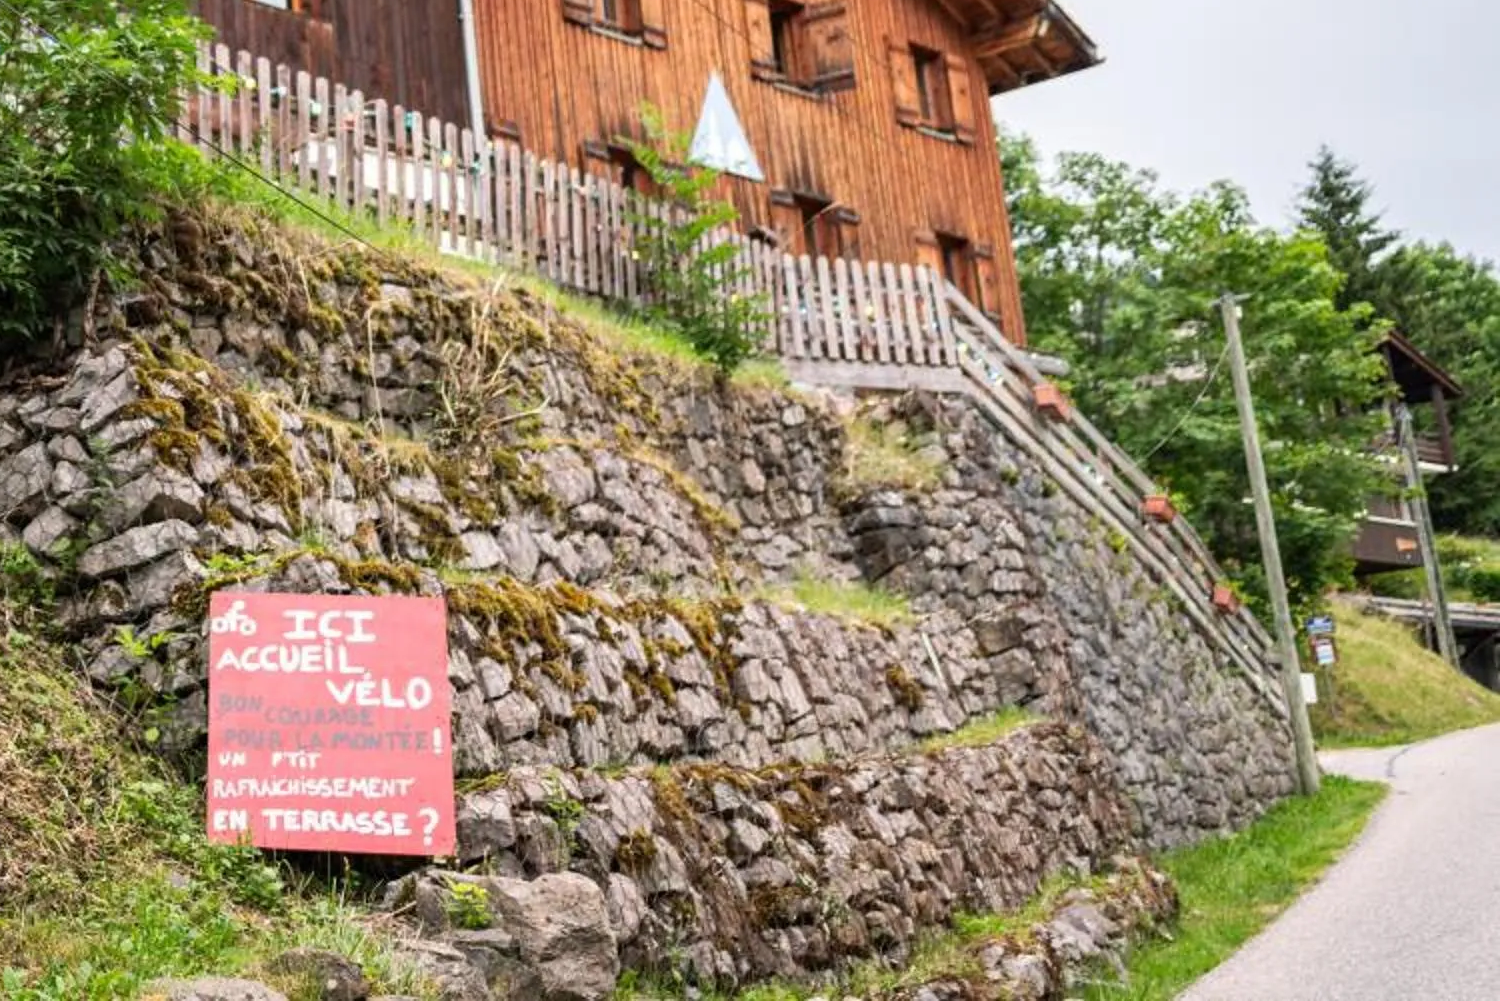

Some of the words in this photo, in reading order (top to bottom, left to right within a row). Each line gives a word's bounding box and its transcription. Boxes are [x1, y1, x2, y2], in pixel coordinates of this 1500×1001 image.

[283, 609, 376, 642] ICI
[325, 670, 432, 710] VÉLO
[219, 694, 263, 715] BON
[265, 705, 373, 727] COURAGE
[225, 729, 283, 749] POUR
[295, 731, 323, 750] LA
[219, 752, 246, 767] UN
[213, 808, 247, 832] EN
[261, 807, 411, 837] TERRASSE
